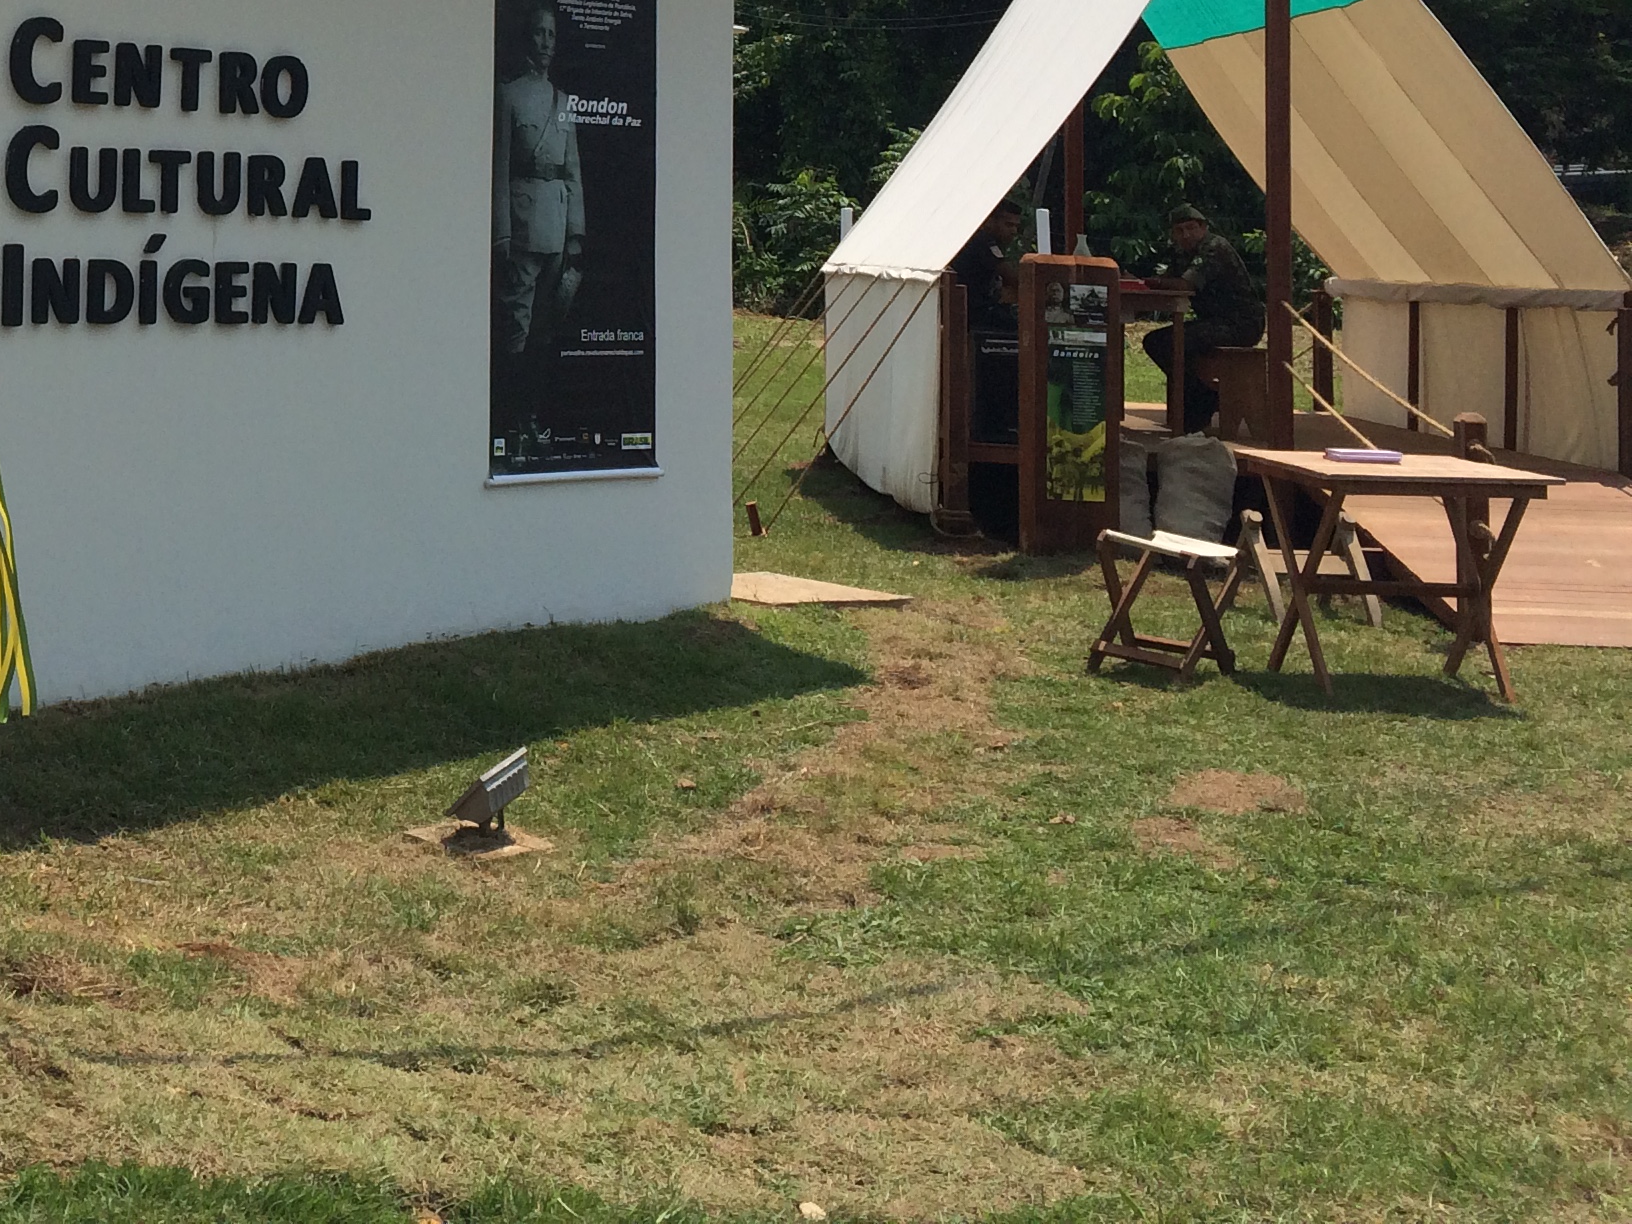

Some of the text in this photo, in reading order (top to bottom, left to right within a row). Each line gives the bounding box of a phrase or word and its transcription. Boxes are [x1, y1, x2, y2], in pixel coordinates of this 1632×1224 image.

[9, 16, 309, 118] CENTRO
[566, 94, 628, 115] Rondon
[558, 112, 642, 127] O Marechal da Paz
[5, 125, 372, 221] CULTURAL
[1, 233, 345, 327] INDÍGENA
[580, 328, 644, 342] Entrada franca
[1052, 349, 1100, 359] Bandeira
